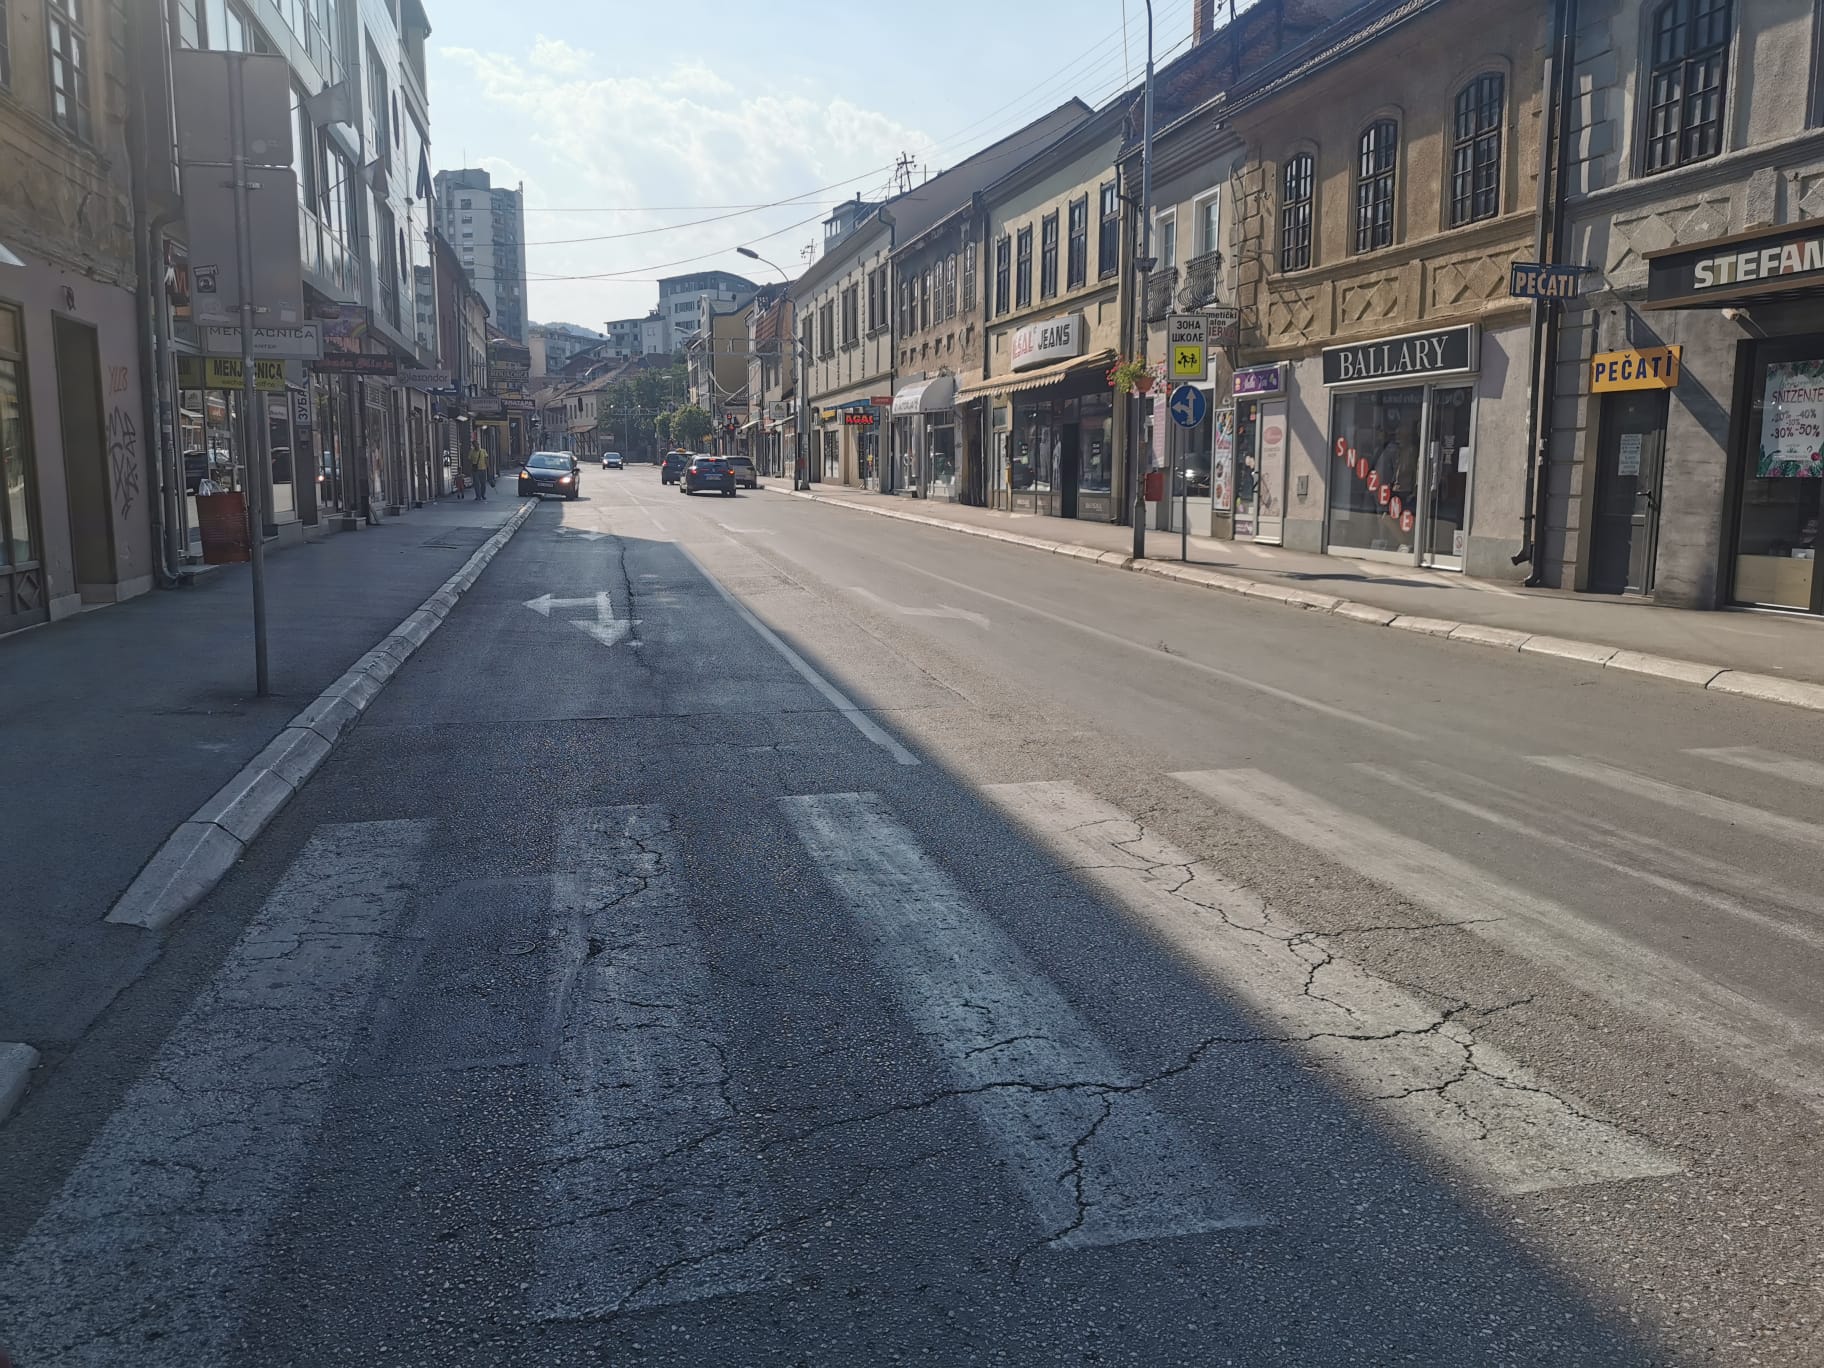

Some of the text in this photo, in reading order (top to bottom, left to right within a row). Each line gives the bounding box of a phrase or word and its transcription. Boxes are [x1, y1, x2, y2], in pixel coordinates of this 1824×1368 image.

[1515, 269, 1574, 297] PEČATI
[1176, 320, 1201, 330] ЗОНА
[1037, 323, 1071, 351] JEANS
[1172, 333, 1205, 342] ШКОЛЕ
[1338, 335, 1449, 380] BALLARY
[1771, 424, 1820, 439] -30% -50%
